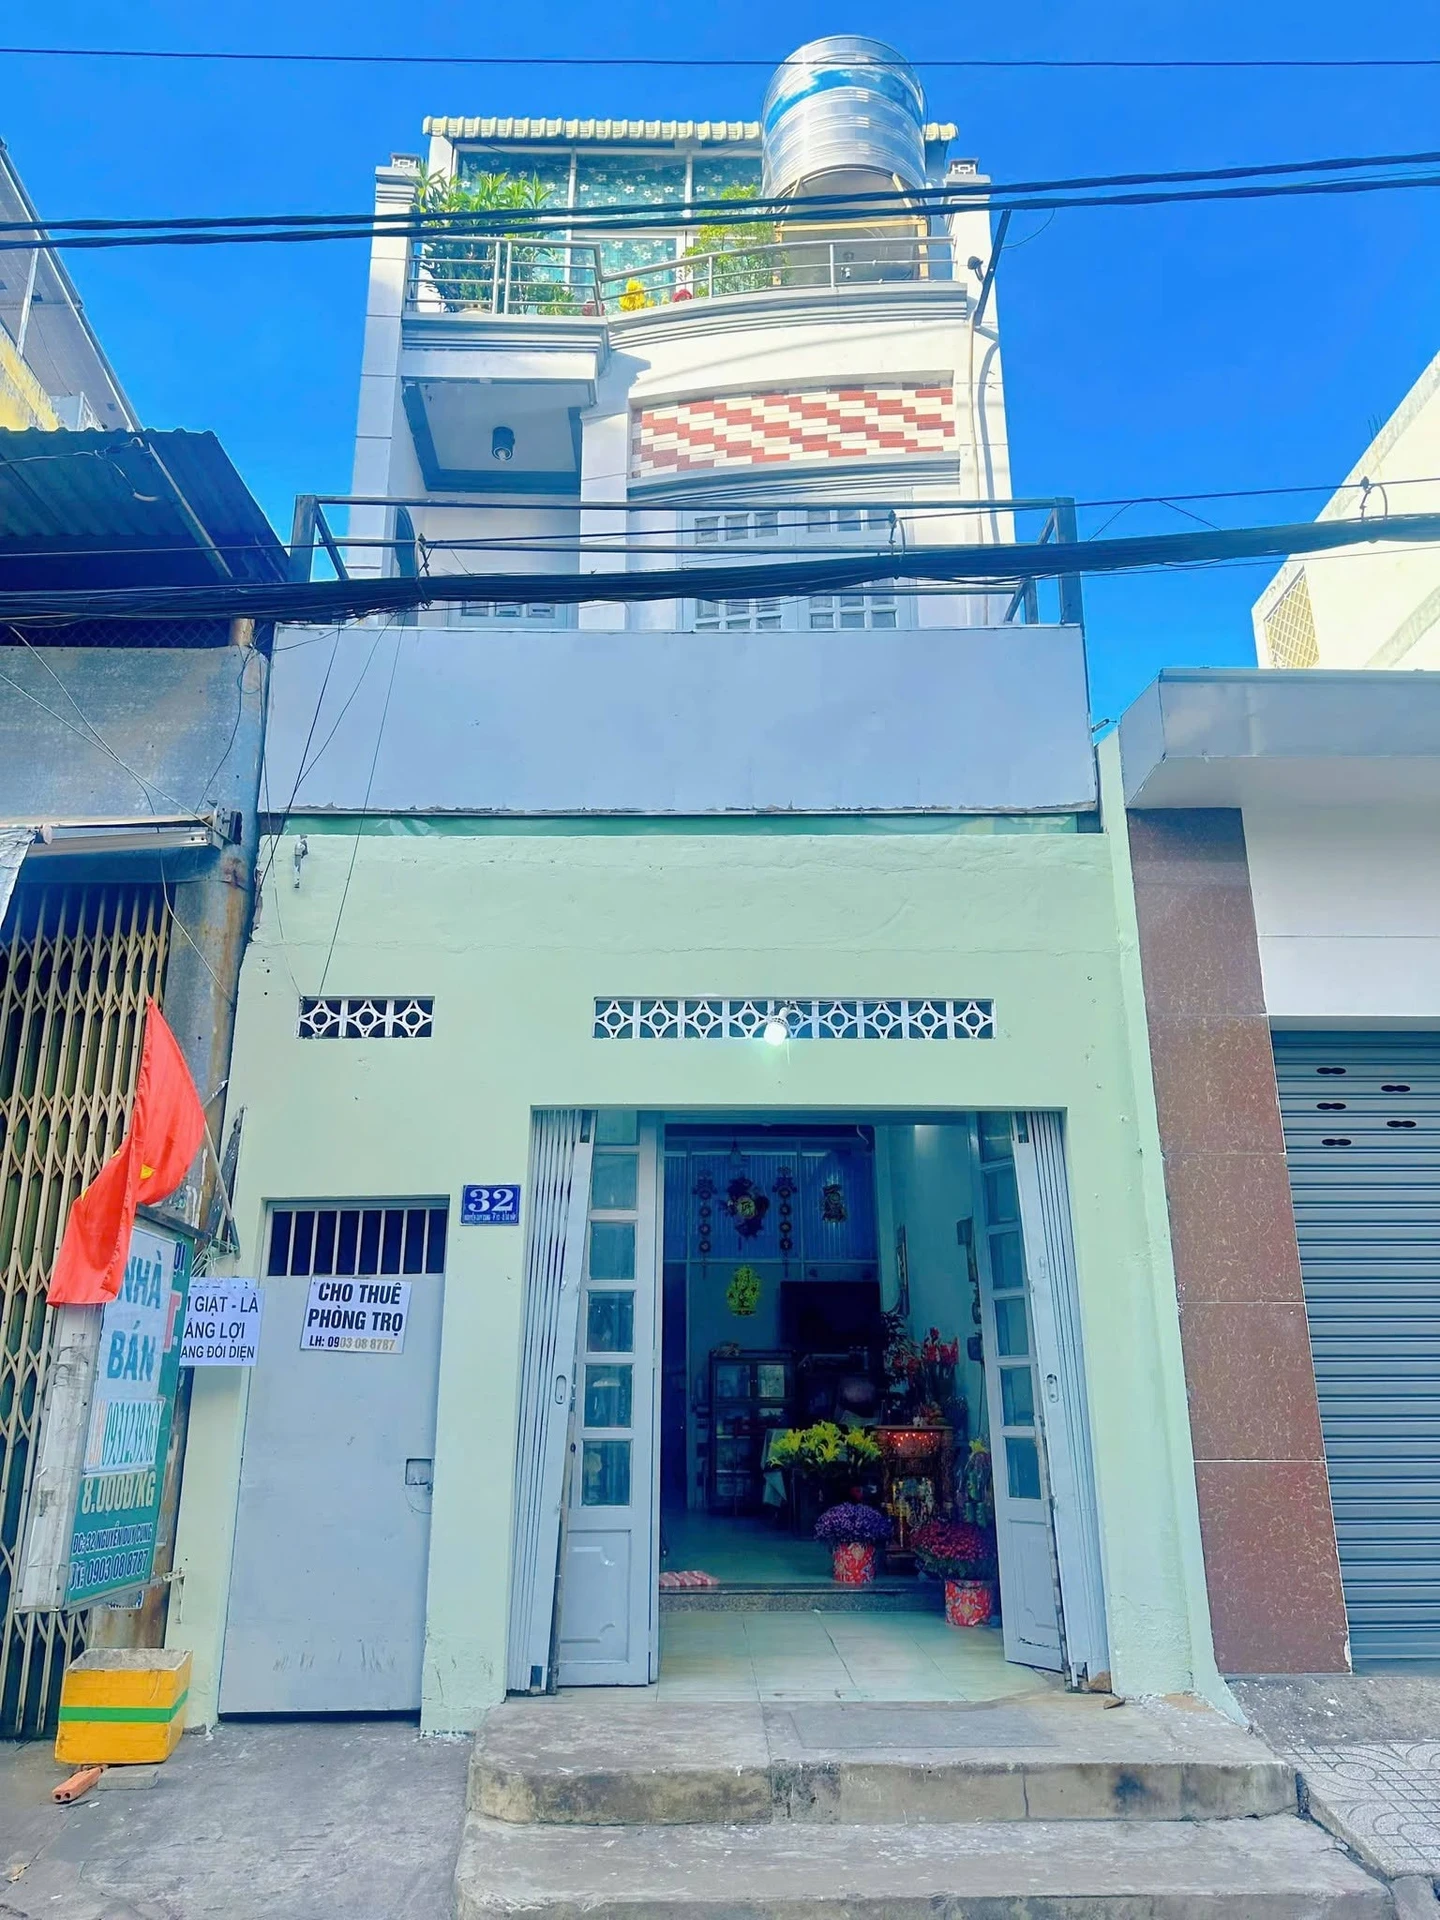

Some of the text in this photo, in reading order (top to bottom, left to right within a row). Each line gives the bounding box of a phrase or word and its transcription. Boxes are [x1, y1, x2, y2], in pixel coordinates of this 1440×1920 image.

[468, 1188, 514, 1212] 32
[118, 1250, 162, 1309] NHÀ
[240, 1292, 259, 1313] LÀ
[318, 1282, 402, 1304] CHO THUÊ
[220, 1322, 245, 1343] LỢI
[307, 1305, 404, 1336] PHÒNG TRỌ
[107, 1320, 156, 1381] BÁN
[309, 1335, 396, 1351] LH: 0903 08 8787
[86, 1556, 112, 1586] 0903
[111, 1553, 126, 1580] 08
[126, 1549, 150, 1578] 8787
